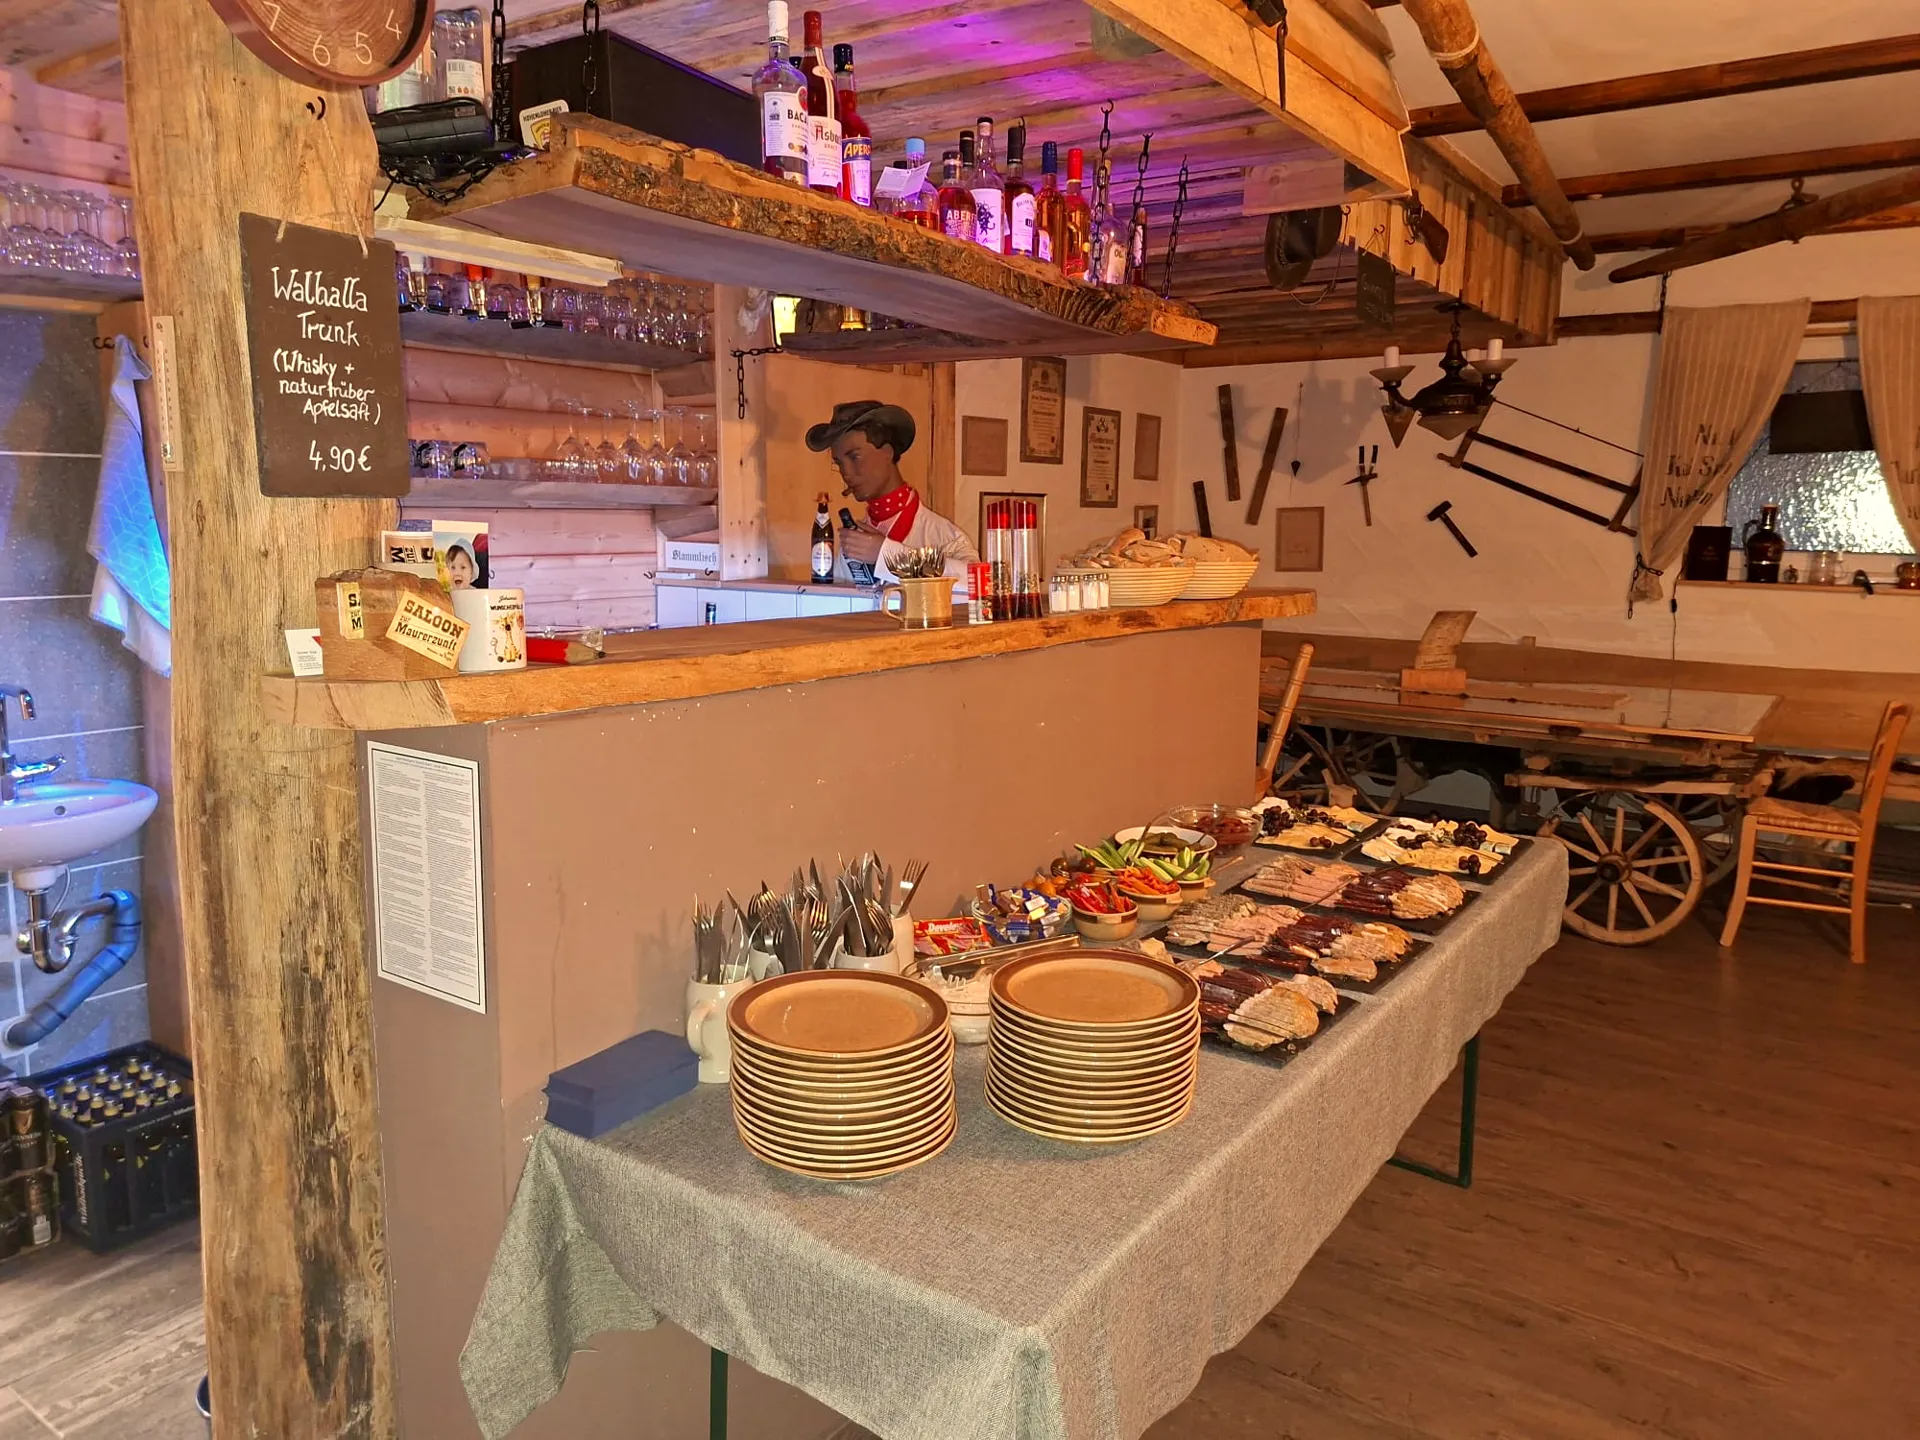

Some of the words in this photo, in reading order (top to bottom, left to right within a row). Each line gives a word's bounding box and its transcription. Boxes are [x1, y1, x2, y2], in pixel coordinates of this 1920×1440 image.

[263, 1, 282, 31] 7
[385, 9, 402, 41] 4
[312, 34, 331, 67] 6
[355, 32, 373, 65] 5
[271, 266, 369, 313] Walhalla
[297, 310, 360, 348] Trunk
[272, 348, 337, 385] (Whisky
[404, 599, 464, 639] SALOON
[394, 621, 458, 651] Maurerzunft
